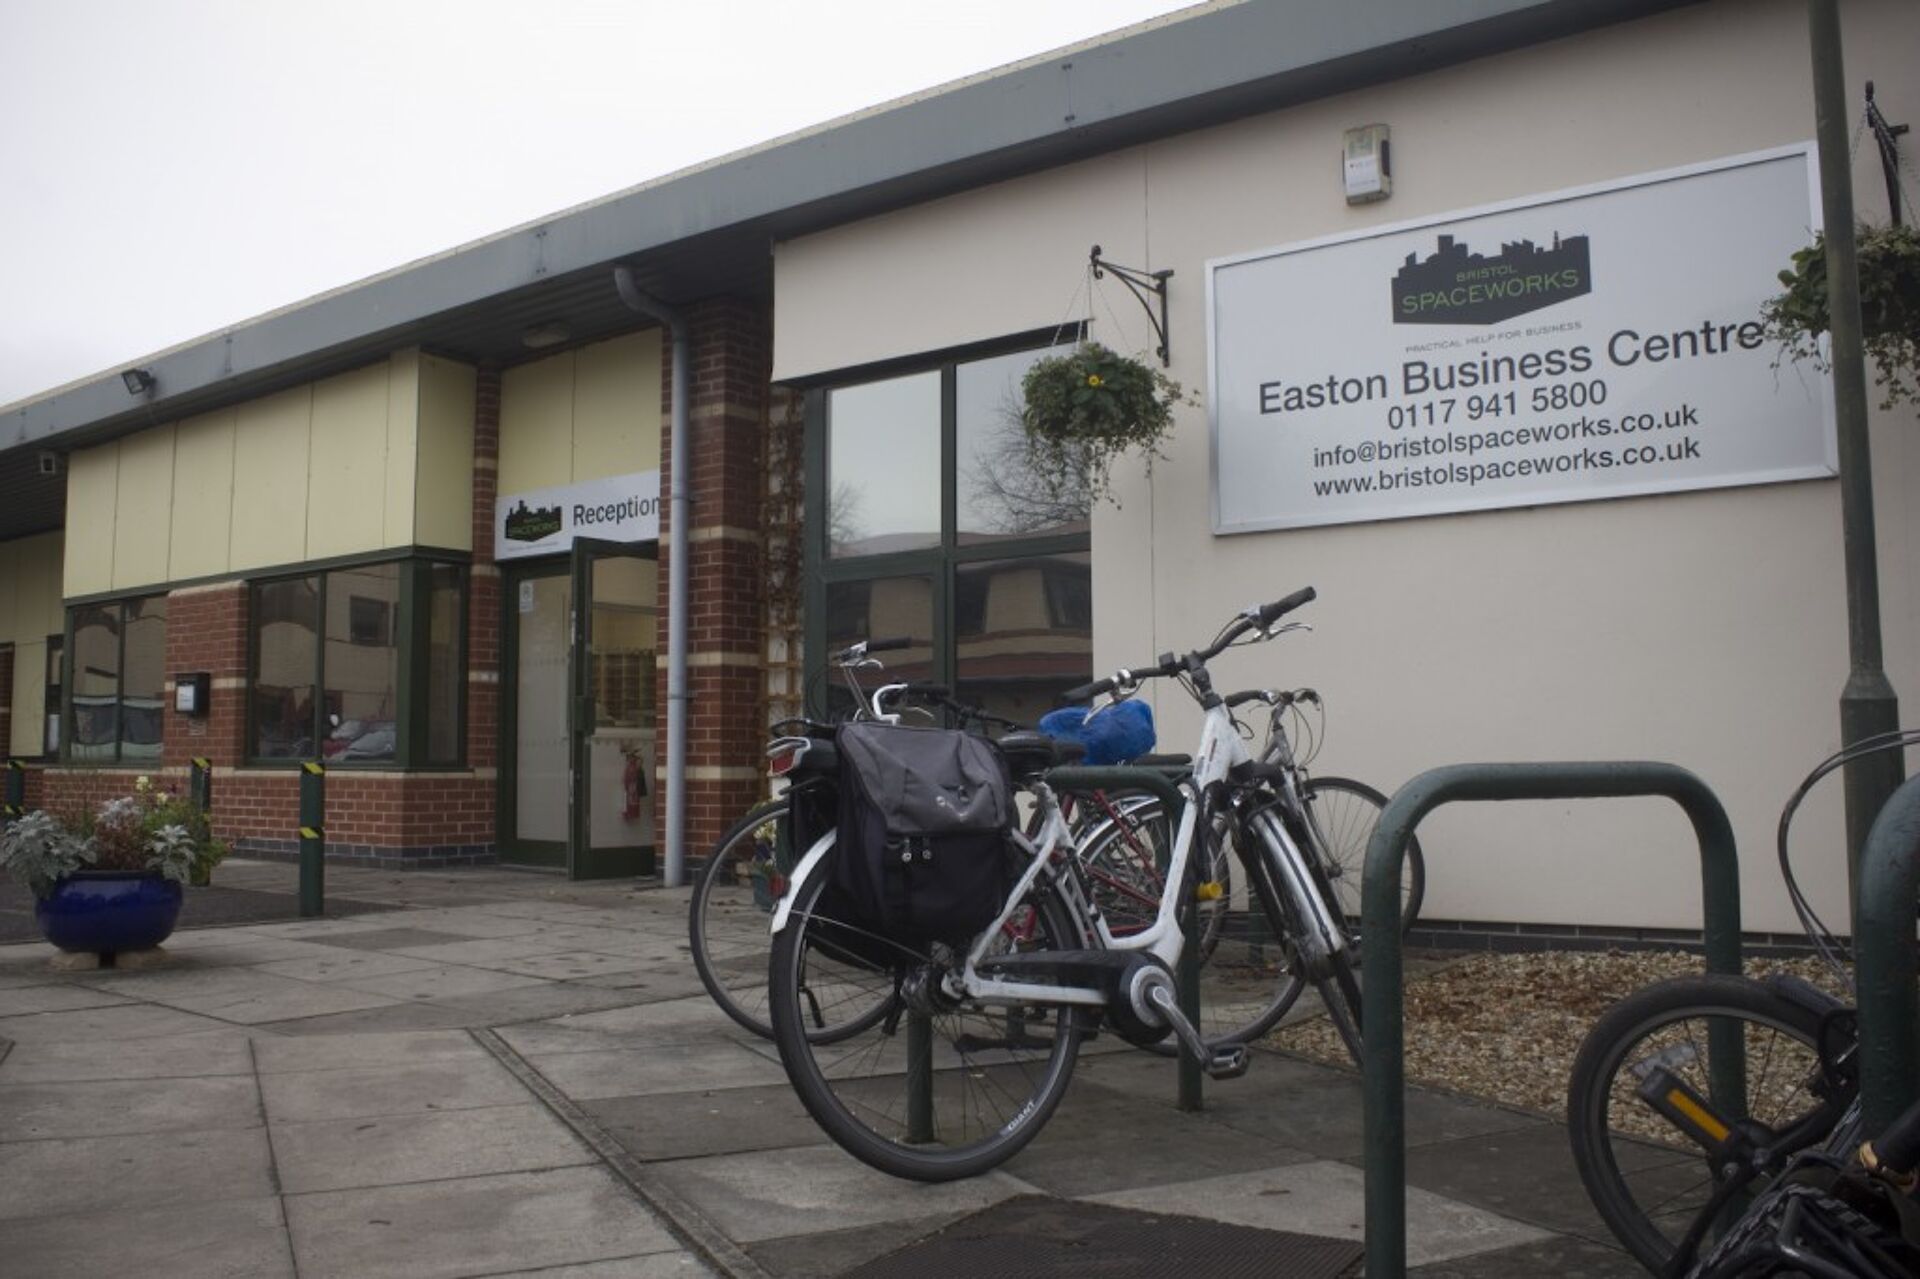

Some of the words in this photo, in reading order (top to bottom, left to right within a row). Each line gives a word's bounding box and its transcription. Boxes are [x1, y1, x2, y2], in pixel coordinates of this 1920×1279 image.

[1402, 269, 1580, 315] SPACEWORKS
[1456, 264, 1518, 283] BRISTOL
[1405, 340, 1462, 354] PRACTICAL
[1466, 333, 1496, 346] HELP
[1499, 329, 1522, 341] FOR
[1526, 321, 1583, 337] BUSINESS
[1259, 373, 1388, 415] Easton
[1403, 345, 1592, 395] Business
[1608, 320, 1765, 366] Centre
[1388, 399, 1456, 430] 0117
[1467, 391, 1516, 421] 941
[1532, 379, 1607, 412] 5800
[1313, 404, 1699, 468] info@bristolspaceworks.co.uk
[1313, 436, 1701, 496] www.bristolspaceworks.co.uk
